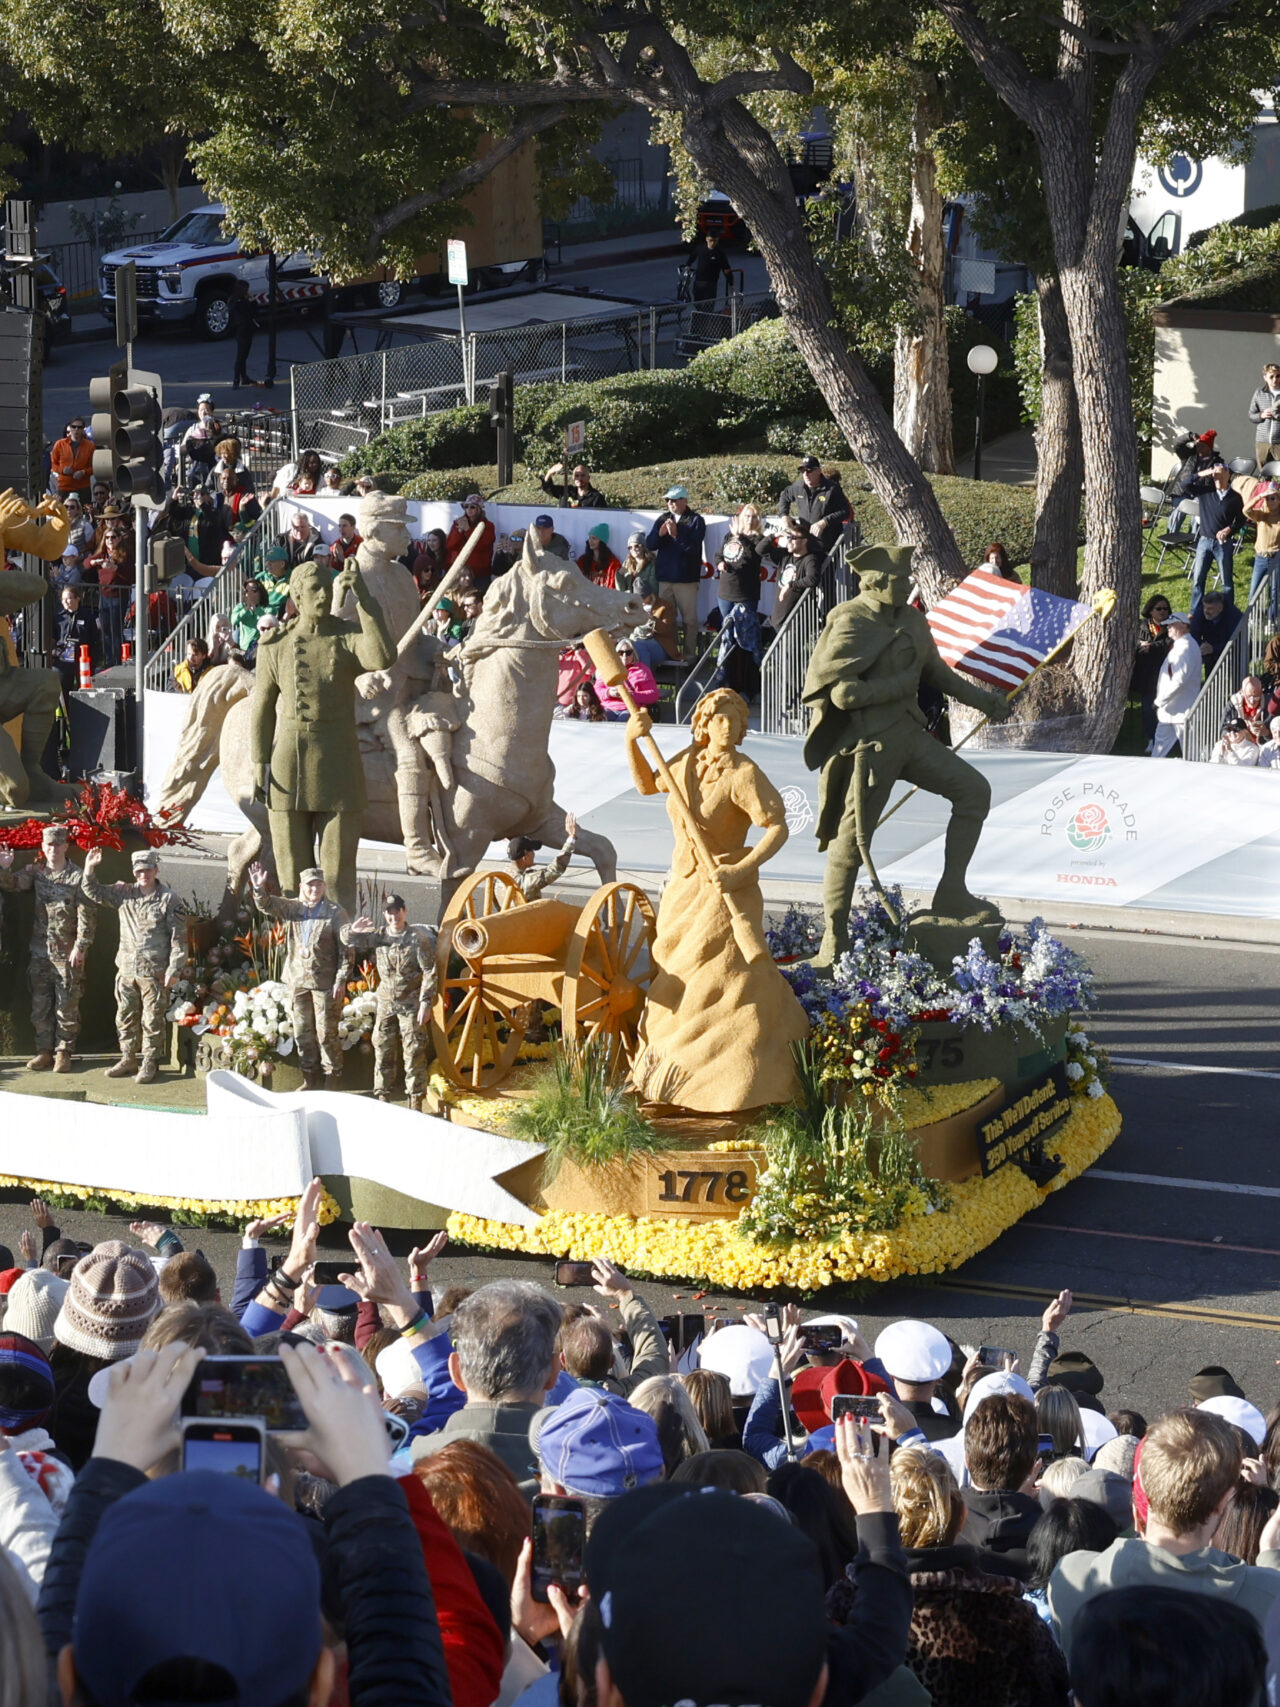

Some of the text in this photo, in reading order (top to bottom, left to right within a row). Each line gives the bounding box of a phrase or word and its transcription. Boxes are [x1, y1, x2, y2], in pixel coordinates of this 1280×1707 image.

[1041, 783, 1138, 841] ROSE PARADE
[1056, 874, 1118, 887] HONDA
[982, 1118, 1004, 1144] This
[986, 1098, 1070, 1170] 250 Years of Service
[658, 1170, 749, 1202] 1778
